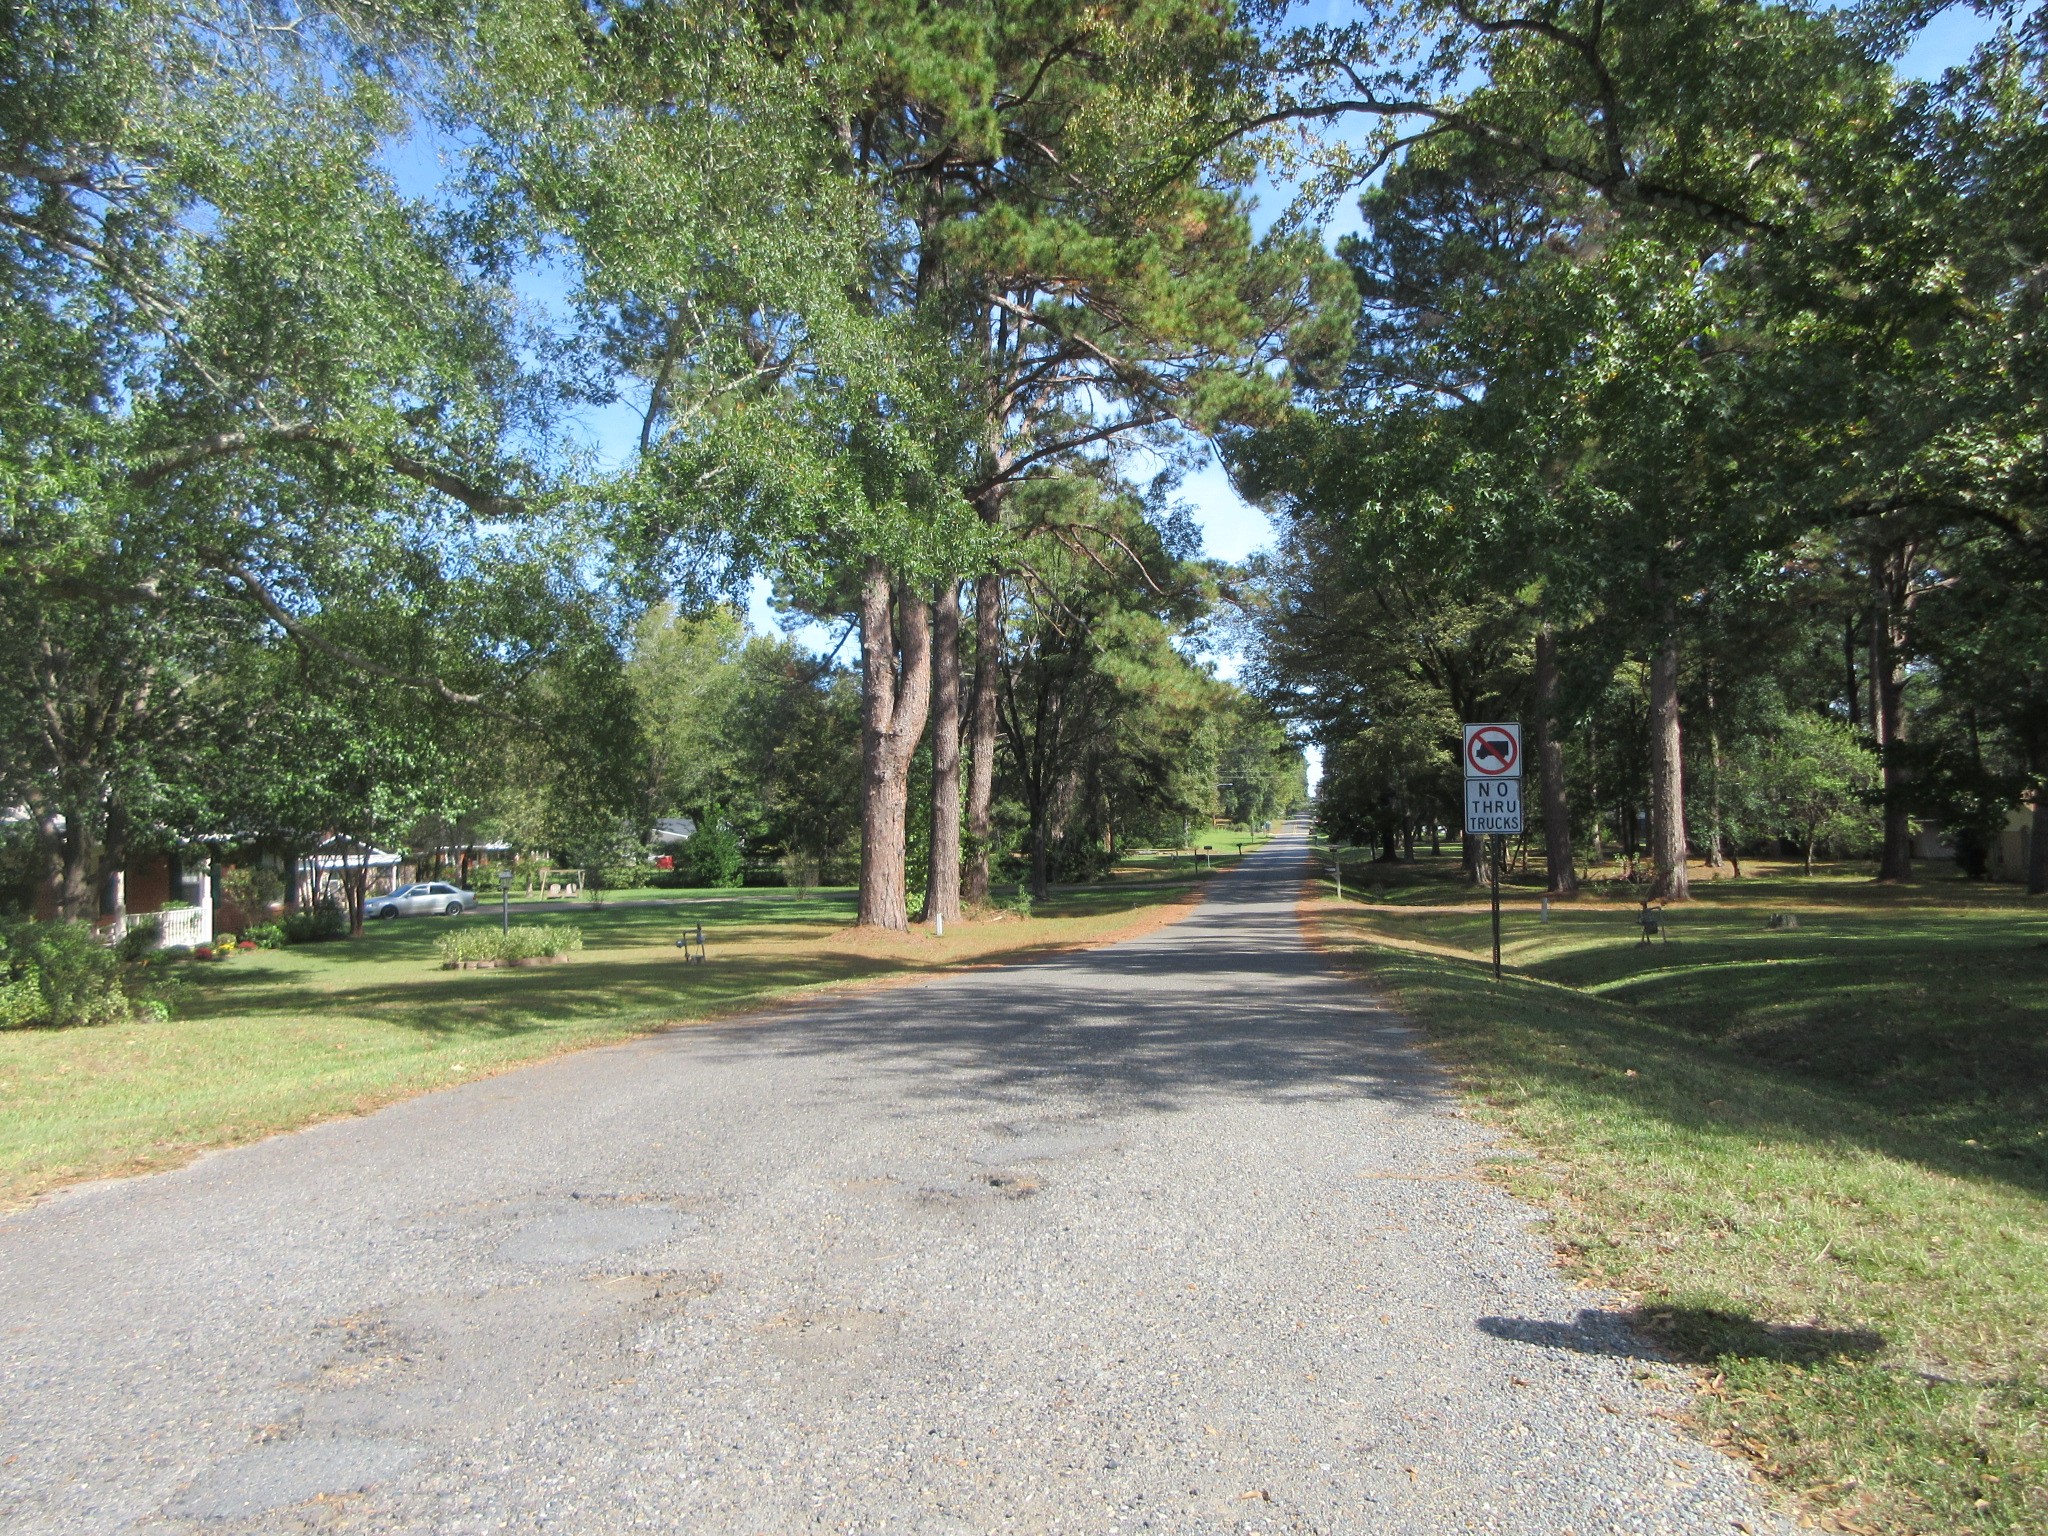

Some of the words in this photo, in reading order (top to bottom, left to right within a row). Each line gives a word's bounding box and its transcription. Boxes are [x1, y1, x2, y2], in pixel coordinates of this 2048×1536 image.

[1479, 782, 1508, 797] NO
[1472, 801, 1516, 813] THRU
[1470, 817, 1519, 830] TRUCKS
